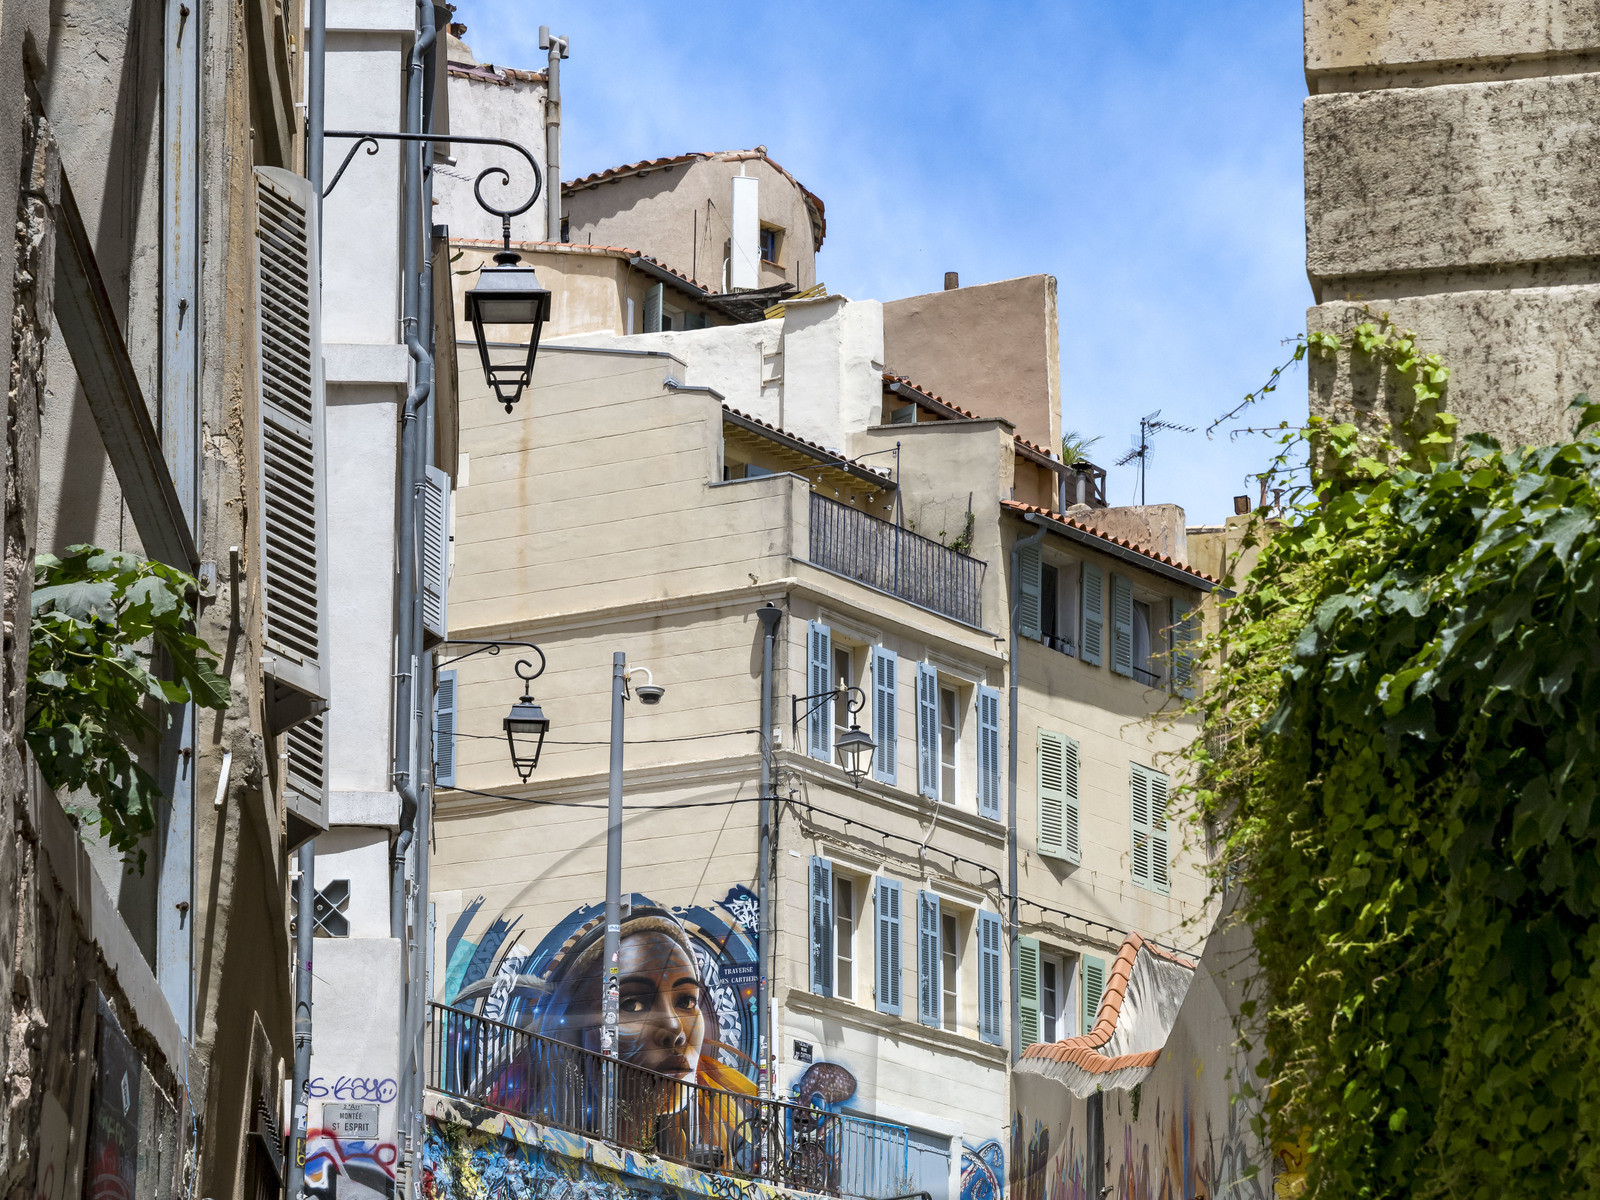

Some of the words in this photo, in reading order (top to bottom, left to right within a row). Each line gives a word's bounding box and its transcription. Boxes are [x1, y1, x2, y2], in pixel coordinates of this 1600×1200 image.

[724, 967, 754, 975] TRAVERSE
[731, 975, 759, 984] CARTIERS
[340, 1111, 362, 1120] MONTÉE
[344, 1122, 369, 1131] ESPRIT
